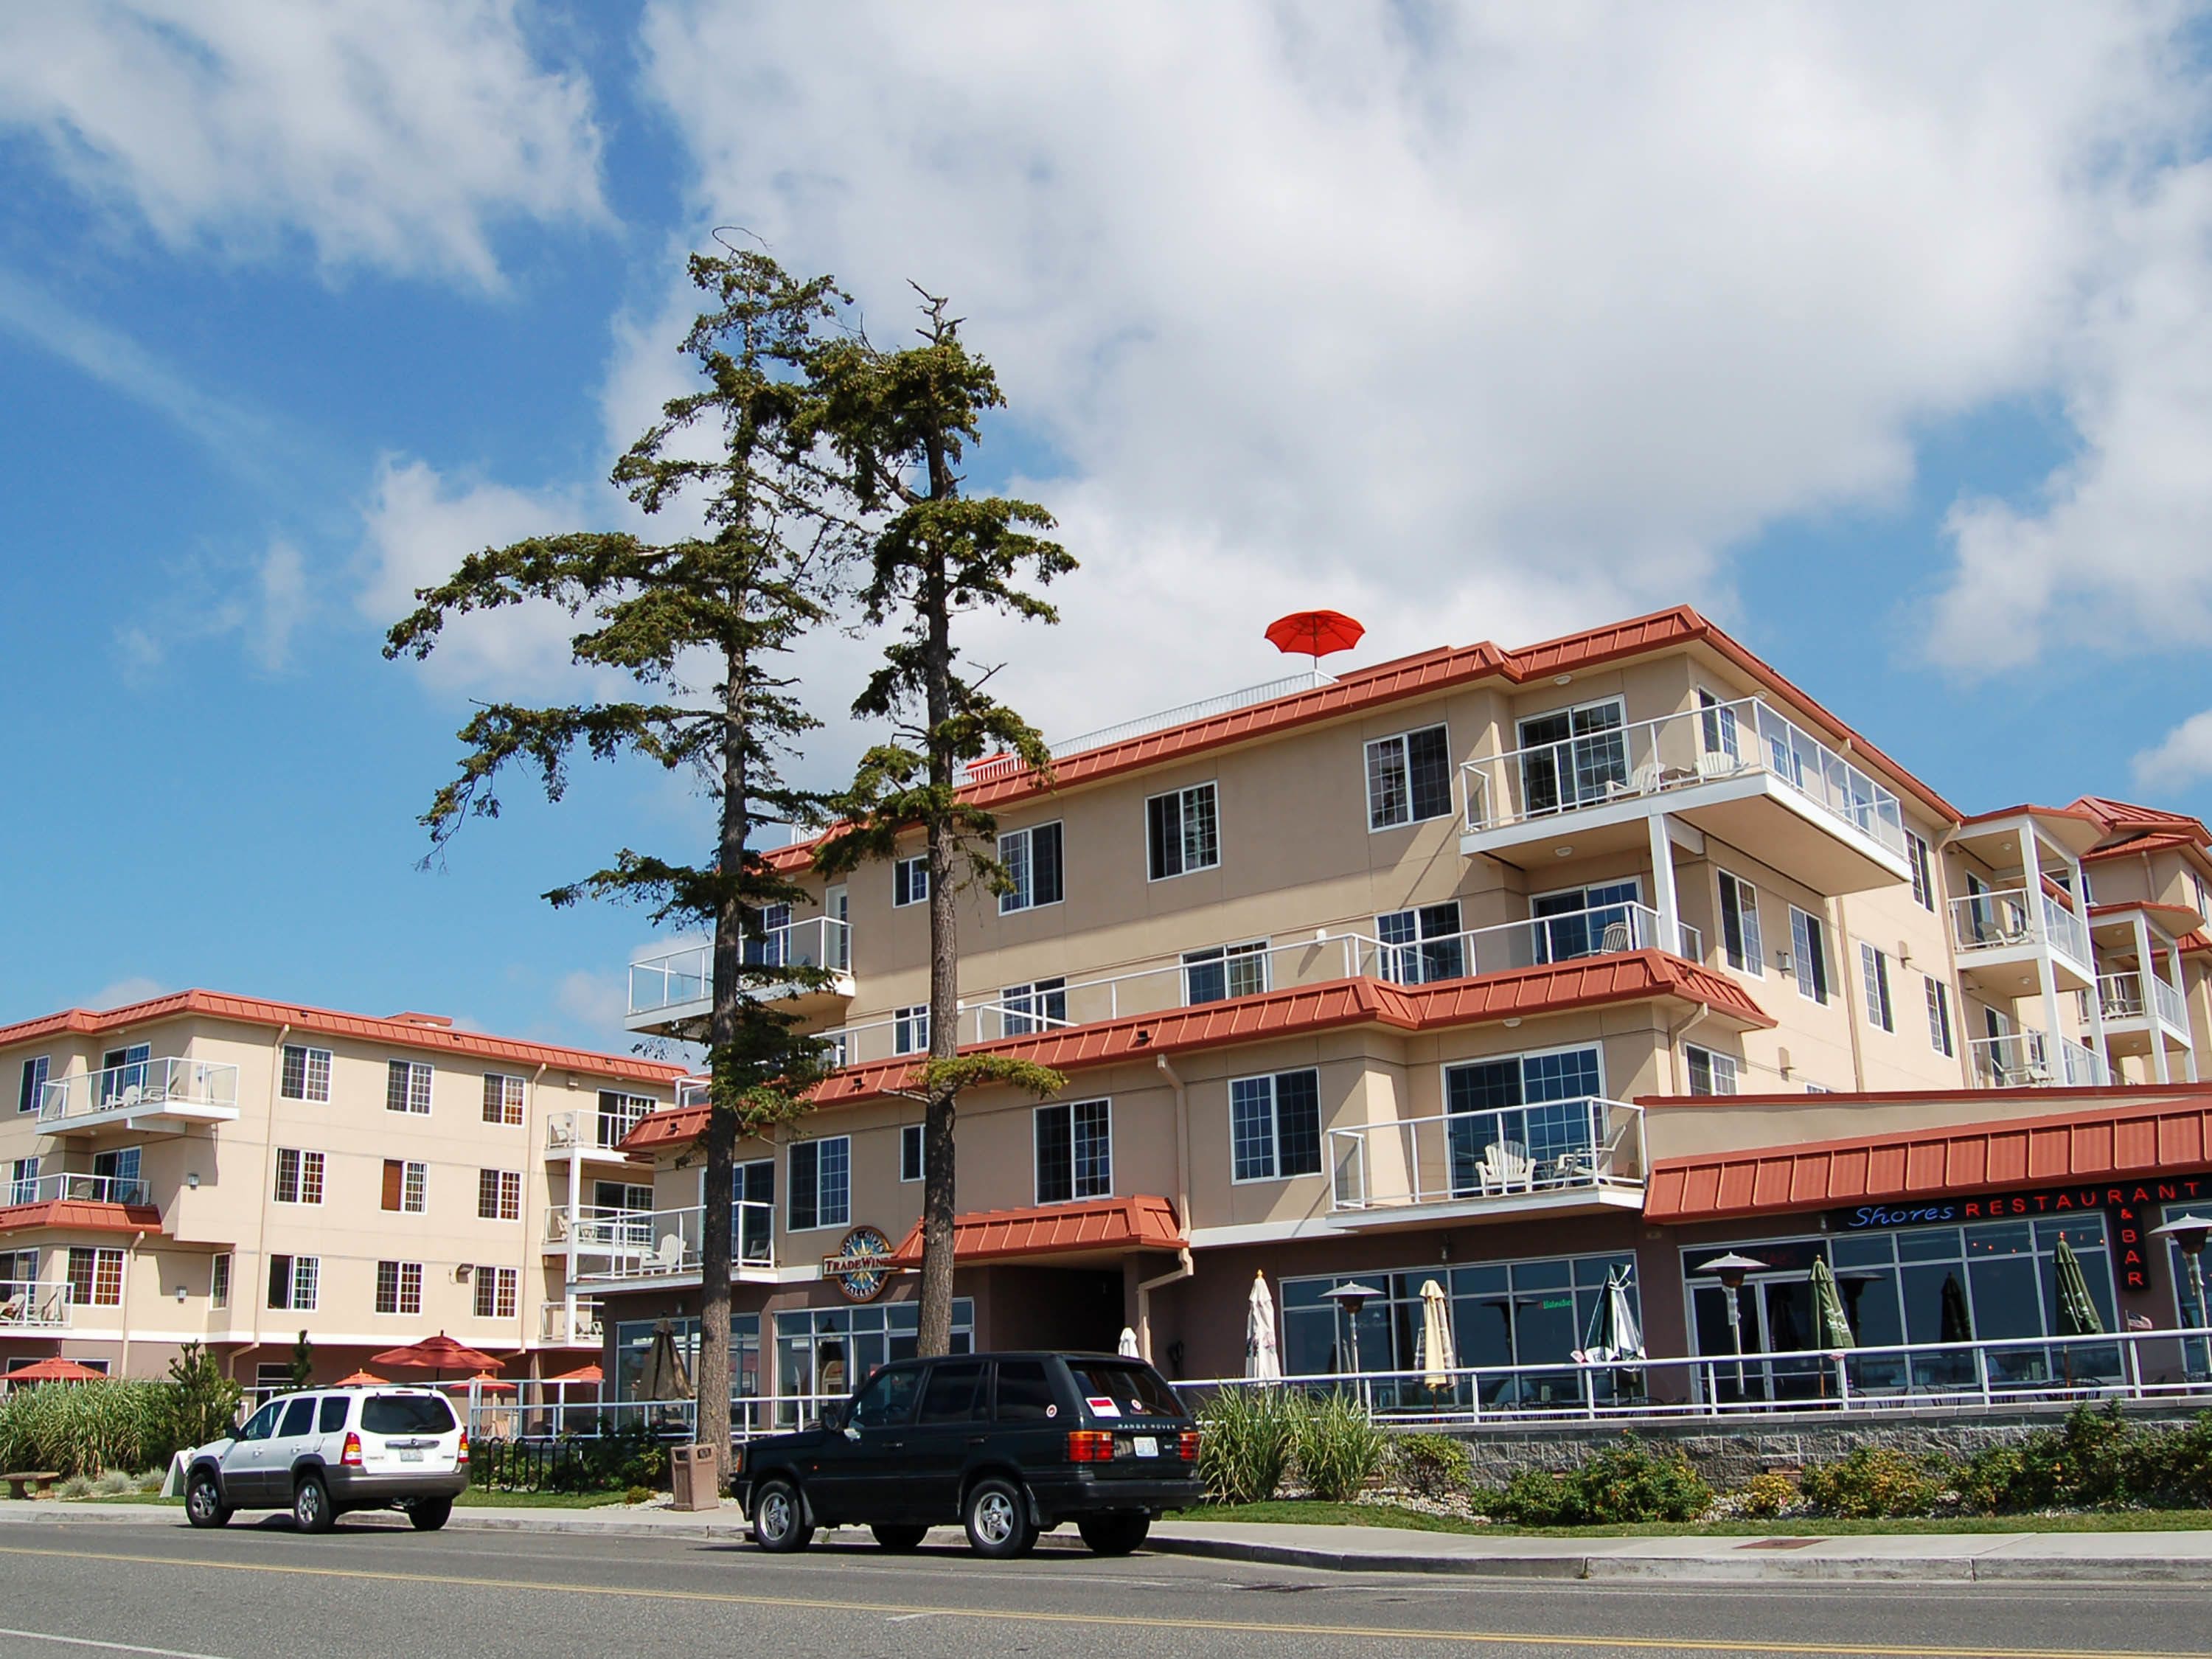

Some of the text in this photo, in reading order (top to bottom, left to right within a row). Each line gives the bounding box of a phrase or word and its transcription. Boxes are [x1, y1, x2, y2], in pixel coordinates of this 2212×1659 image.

[1848, 1181, 2201, 1226] Shores RESTAURANT
[2121, 1208, 2143, 1285] & BAR
